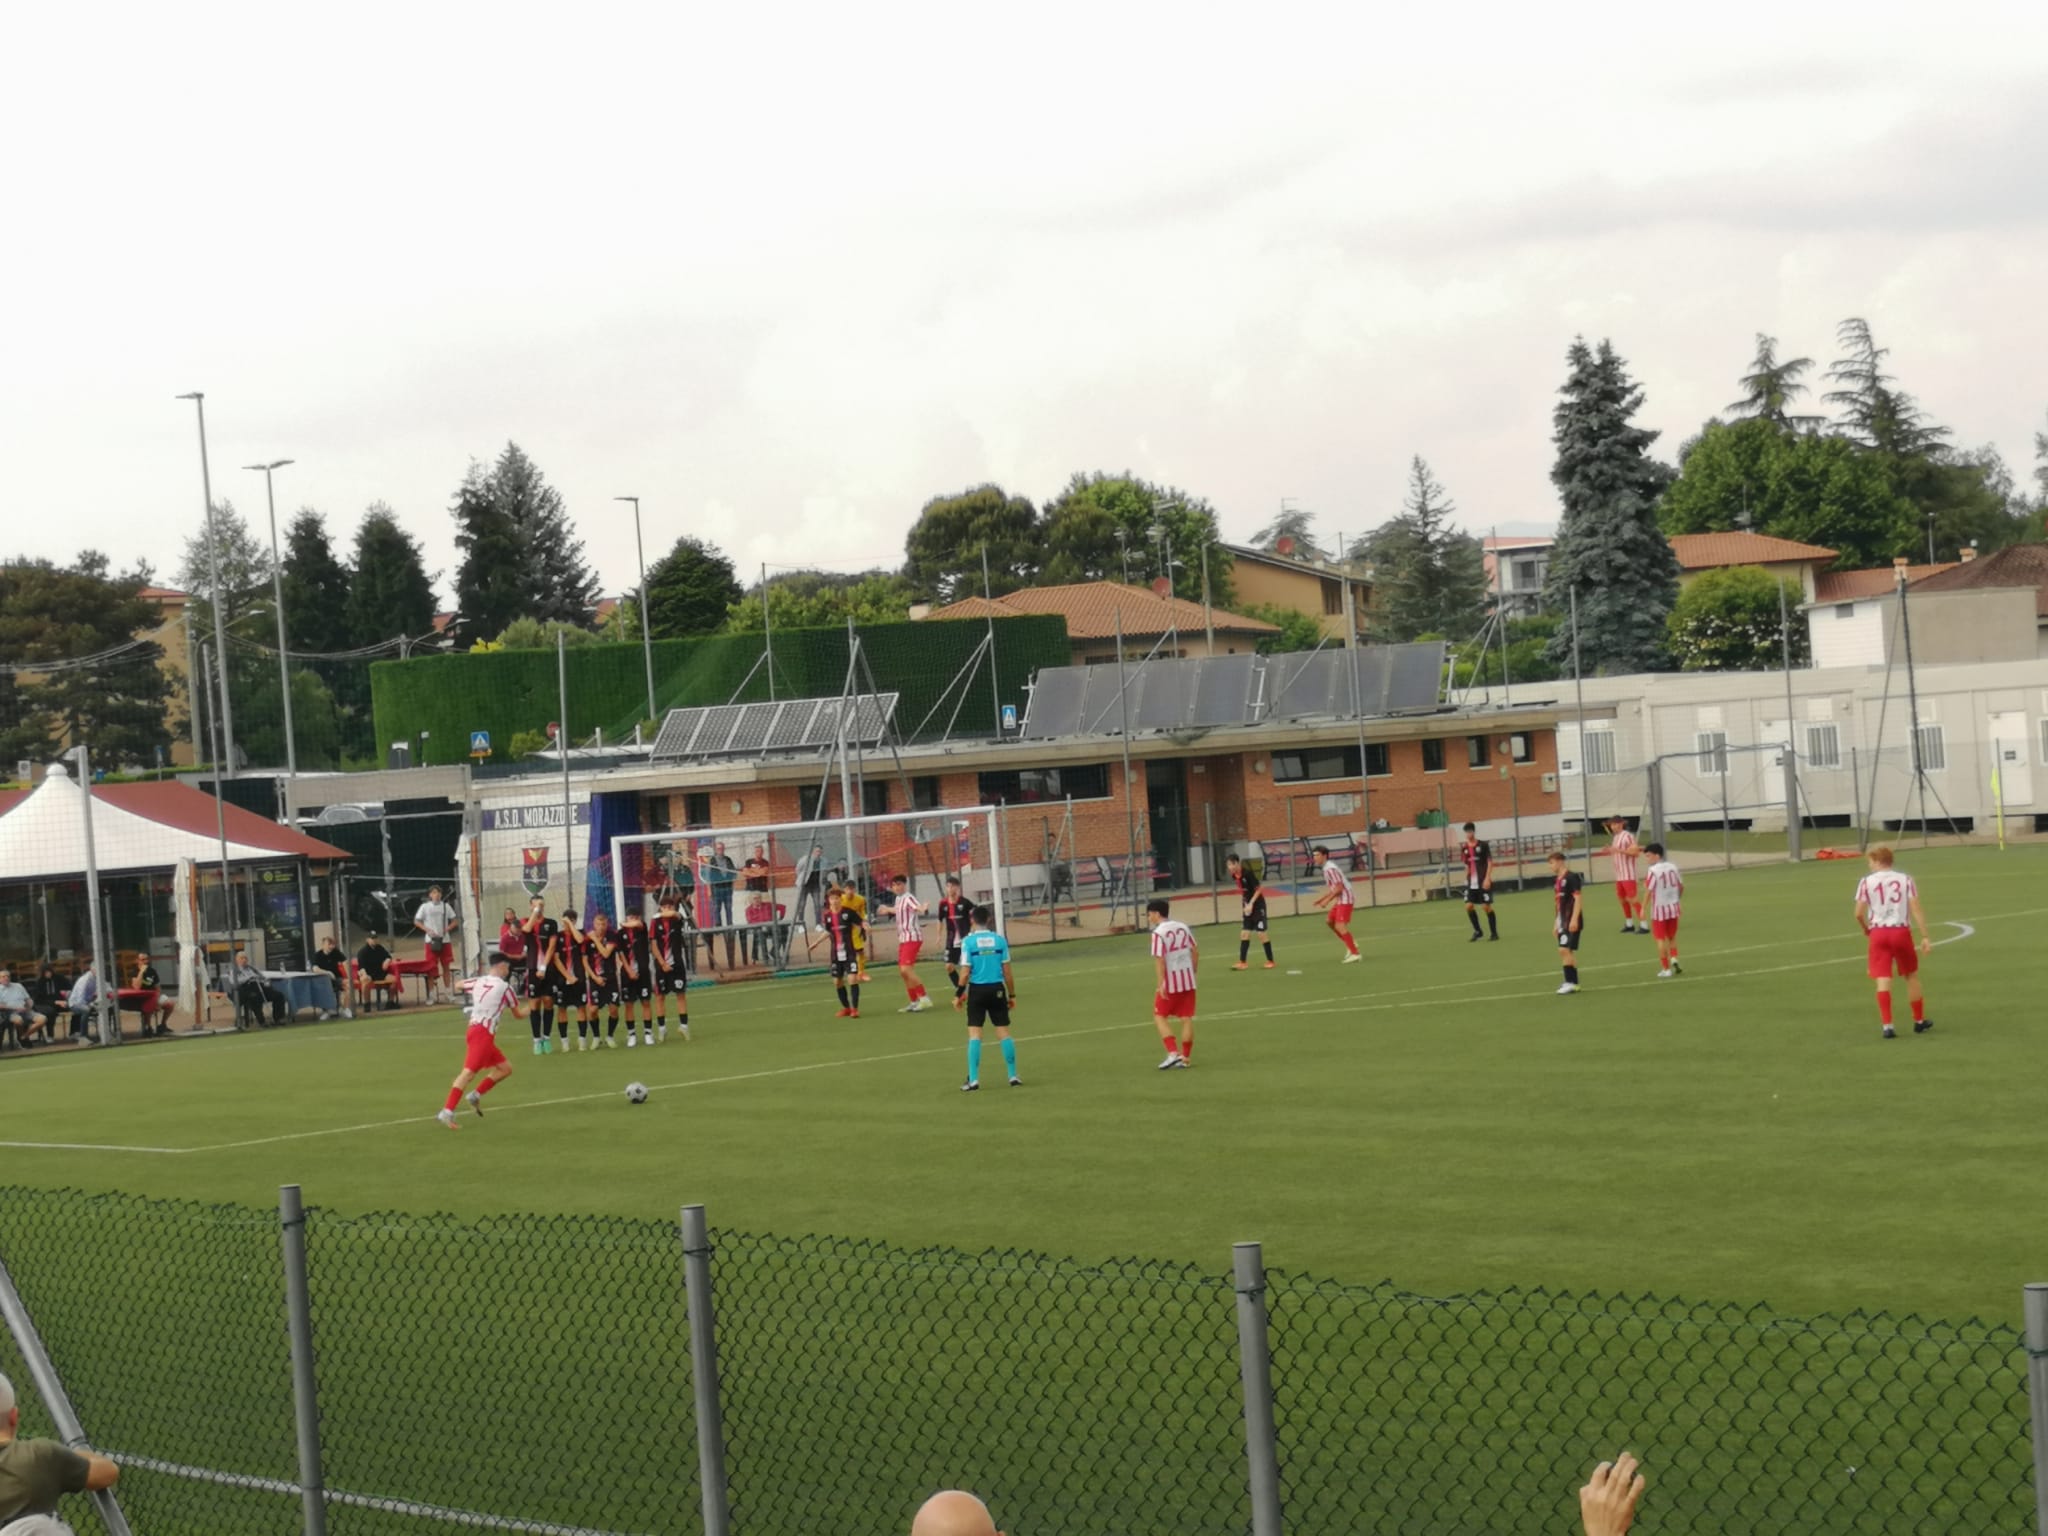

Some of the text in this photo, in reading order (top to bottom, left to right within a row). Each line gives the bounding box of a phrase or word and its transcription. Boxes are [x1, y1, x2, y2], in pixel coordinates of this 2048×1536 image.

[494, 809, 522, 829] A.S.D.
[1659, 870, 1678, 888] 10
[1873, 880, 1902, 905] 13
[1166, 928, 1188, 952] 22
[479, 983, 494, 1003] 7
